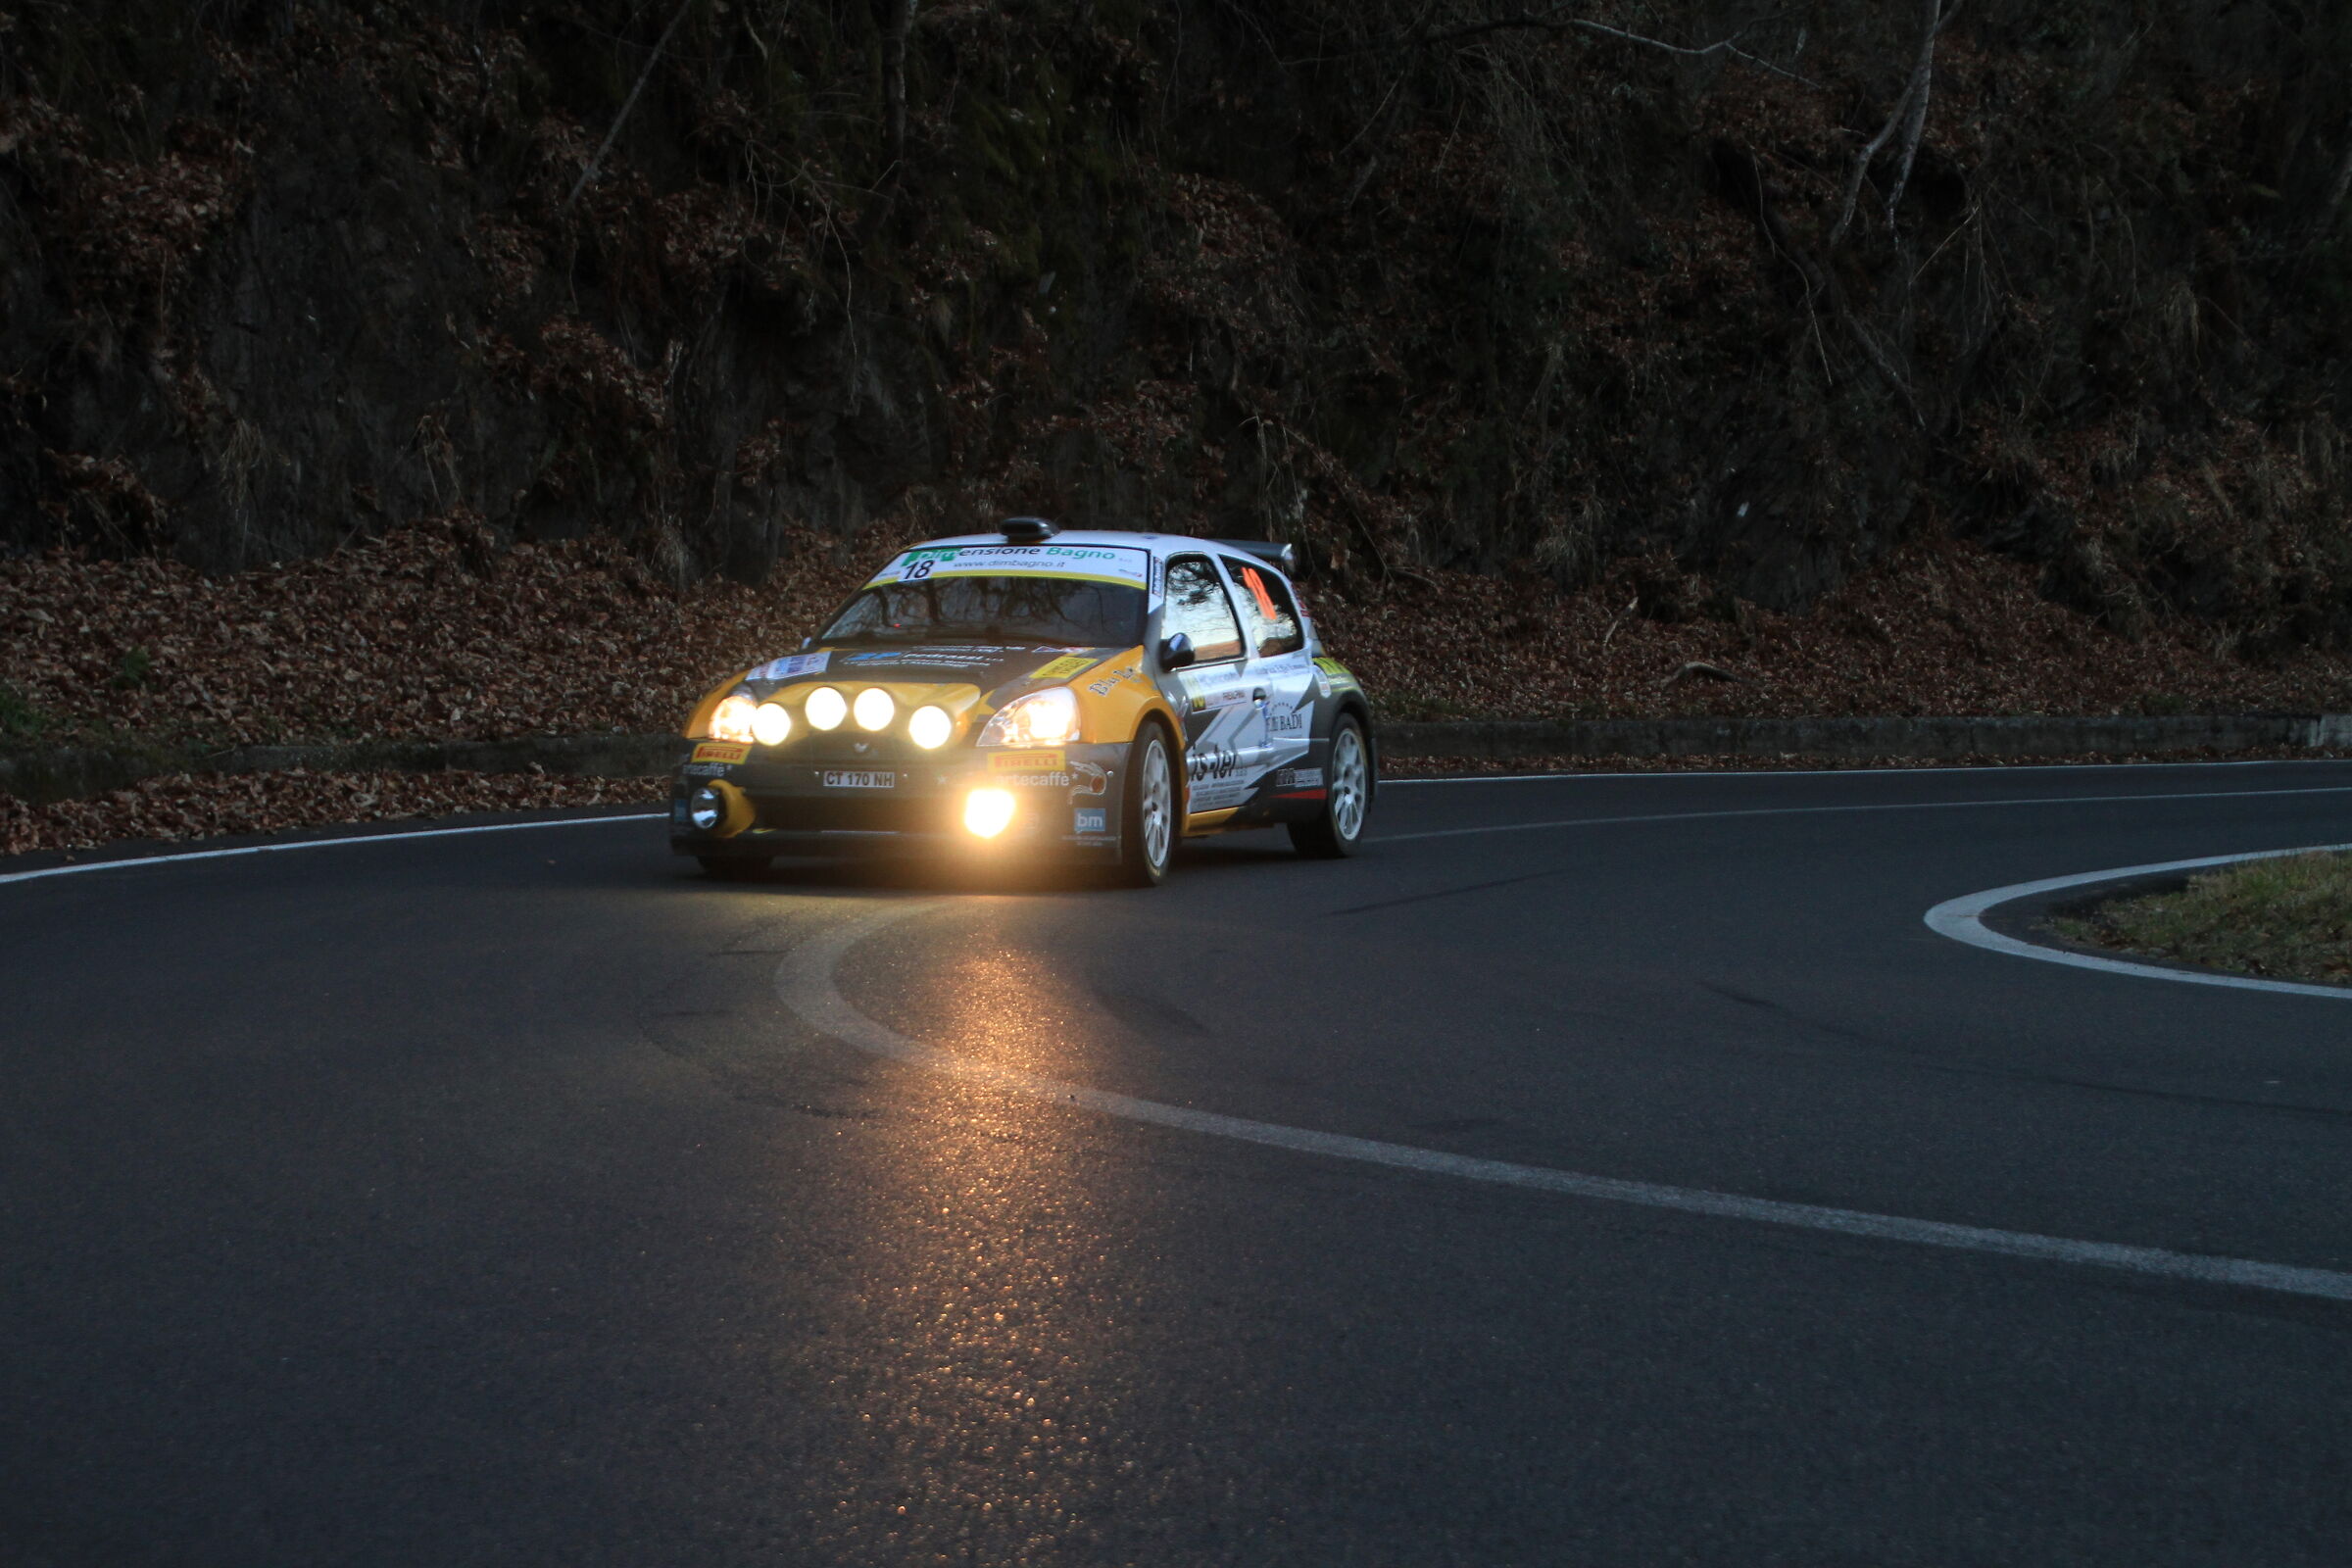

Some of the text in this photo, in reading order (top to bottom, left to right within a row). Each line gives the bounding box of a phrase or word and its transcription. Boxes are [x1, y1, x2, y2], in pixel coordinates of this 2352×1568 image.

[1046, 547, 1115, 561] Bagno
[904, 560, 934, 580] 18
[953, 560, 1065, 570] www.dimbagno.it
[696, 746, 744, 760] PIRELLI
[995, 752, 1058, 768] PIRELLI
[826, 772, 894, 787] CT 170 NH
[1077, 813, 1103, 827] bm
